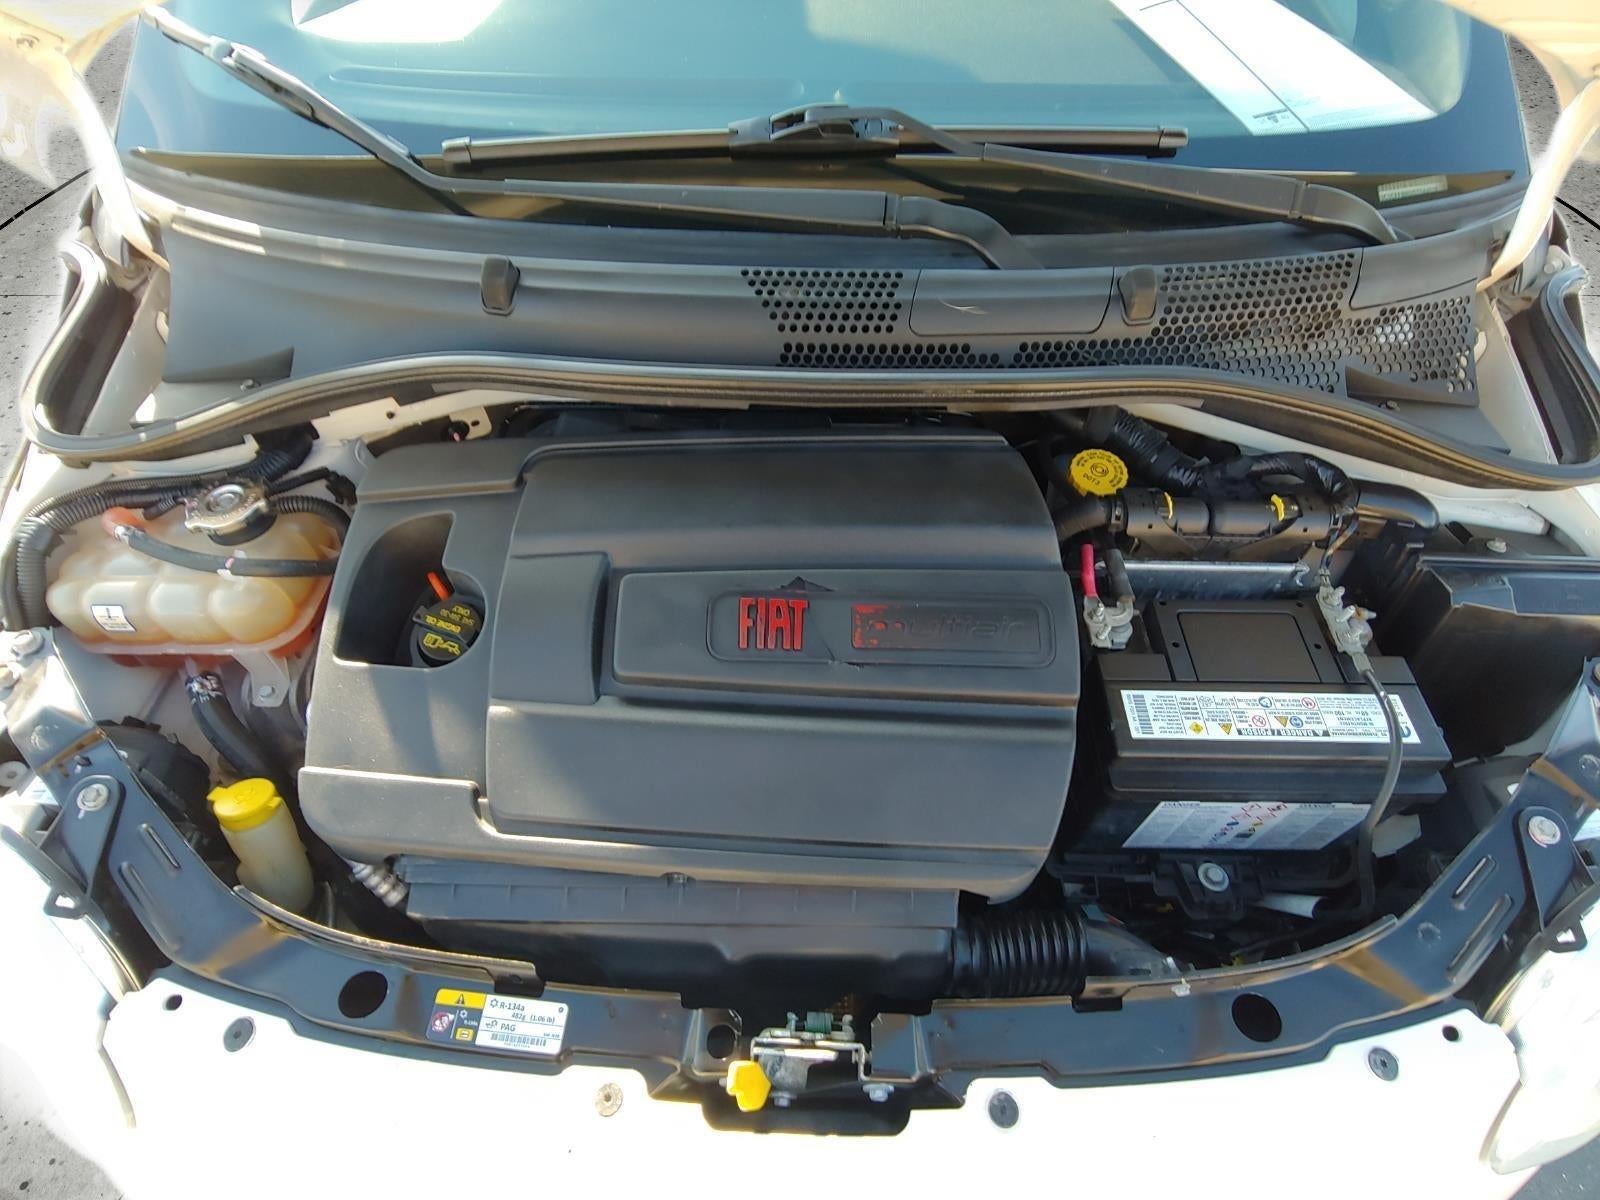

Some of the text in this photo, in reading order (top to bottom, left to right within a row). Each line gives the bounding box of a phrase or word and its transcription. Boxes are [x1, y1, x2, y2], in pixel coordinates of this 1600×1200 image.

[738, 597, 808, 650] FIAT
[499, 1001, 525, 1012] R-134a
[500, 1022, 516, 1032] PAG
